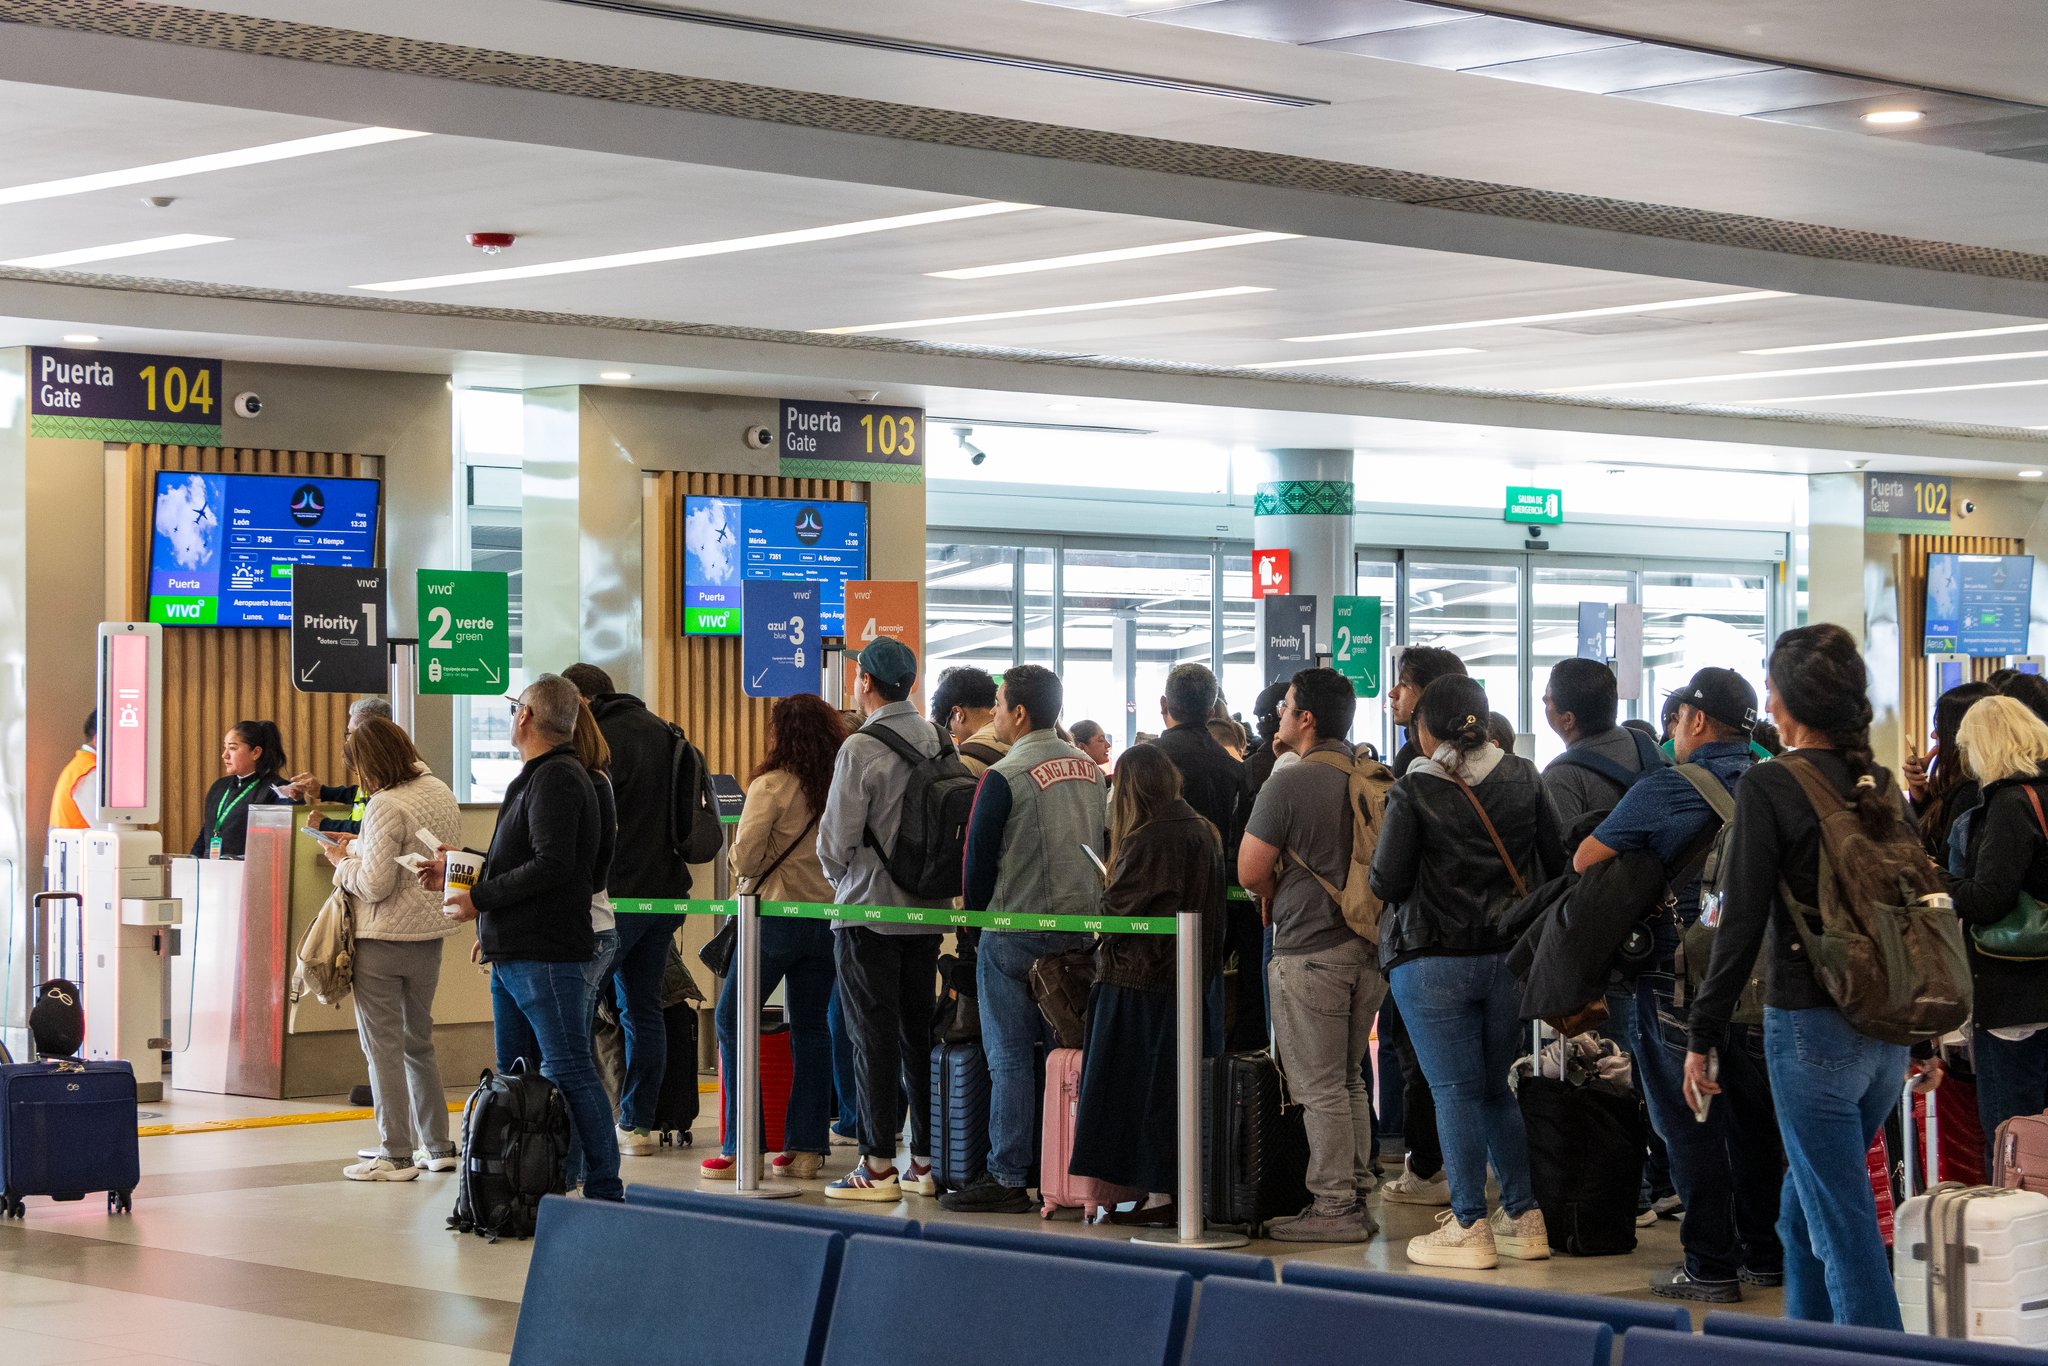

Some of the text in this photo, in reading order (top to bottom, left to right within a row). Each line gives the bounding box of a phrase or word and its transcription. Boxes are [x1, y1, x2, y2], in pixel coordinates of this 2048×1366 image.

[41, 355, 114, 386] Puerta
[139, 365, 214, 414] 104
[40, 385, 82, 409] Gate
[787, 406, 842, 433] Puerta
[860, 414, 916, 457] 103
[786, 432, 817, 452] Gate
[1871, 478, 1904, 497] Puerta
[1914, 482, 1948, 515] 102
[1871, 497, 1889, 512] Gate
[233, 518, 250, 526] León
[350, 520, 367, 528] 13:20
[257, 536, 273, 544] 7345
[323, 537, 345, 546] tiempo
[749, 537, 767, 545] Mérida
[168, 578, 200, 589] Puerta
[356, 579, 378, 588] viva
[427, 583, 454, 595] viva
[699, 592, 725, 601] Puerta
[793, 590, 811, 600] viva
[854, 591, 870, 600] viva
[233, 599, 269, 608] Aeropuerto
[165, 602, 202, 618] viva
[304, 603, 377, 646] Priority 1
[455, 616, 494, 630] verde
[698, 613, 728, 628] viva
[428, 606, 453, 649] 2
[767, 615, 805, 645] azul 3
[861, 617, 904, 642] 4 naranja
[455, 632, 483, 644] green
[773, 632, 787, 640] blue
[1352, 634, 1373, 644] verde
[1271, 624, 1310, 660] Priority 1
[1337, 625, 1351, 661] 2
[1595, 632, 1602, 657] 3
[1351, 647, 1367, 656] green
[1034, 759, 1094, 785] ENGLAND
[450, 862, 475, 876] COLD
[638, 903, 652, 911] viva
[673, 903, 688, 911] viva
[709, 904, 724, 912] viva
[783, 905, 799, 914] viva
[823, 907, 839, 917] viva
[864, 909, 881, 918] viva
[907, 912, 923, 921] viva
[950, 913, 967, 923] viva
[994, 916, 1011, 926] viva
[1038, 918, 1056, 928] viva
[1084, 920, 1102, 930] viva
[1131, 921, 1149, 931] viva
